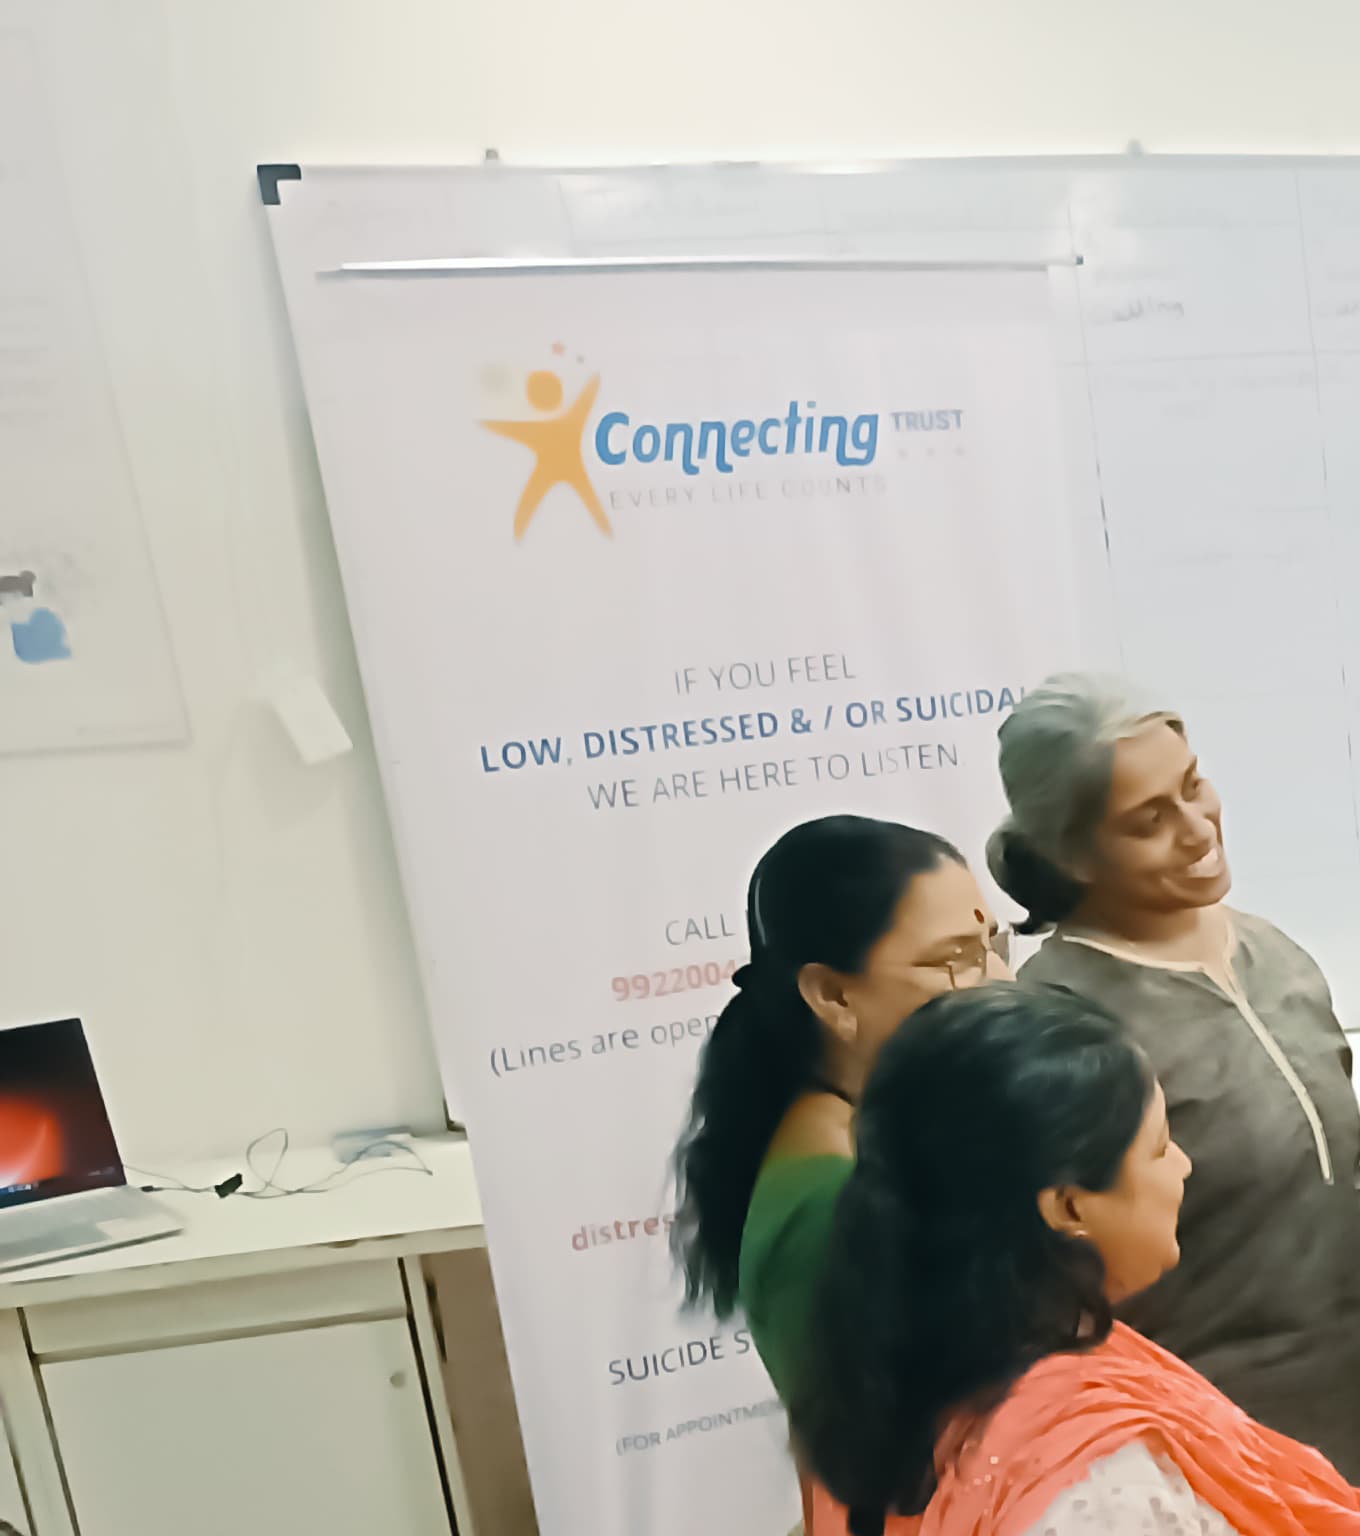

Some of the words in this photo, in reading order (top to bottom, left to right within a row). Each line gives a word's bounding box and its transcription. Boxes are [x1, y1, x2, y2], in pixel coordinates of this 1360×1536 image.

[595, 400, 879, 476] Connecting
[889, 409, 964, 432] TRUST
[609, 486, 697, 510] EVERY
[711, 480, 767, 502] LIFE
[782, 475, 887, 499] COUNTS
[674, 668, 697, 696] IF
[710, 661, 775, 692] YOU
[788, 653, 856, 682] FEEL
[479, 736, 574, 773] LOW,
[584, 710, 779, 759] DISTRESSED
[790, 707, 812, 734] &
[824, 705, 834, 732] /
[845, 700, 886, 730] OR
[896, 686, 1025, 722] SUICIDA
[587, 779, 639, 810] WE
[652, 768, 707, 803] ARE
[720, 758, 798, 793] HERE
[810, 753, 850, 781] TO
[665, 913, 736, 945] CALL
[490, 1039, 581, 1077] (Lines
[591, 1028, 639, 1055] are
[608, 1335, 725, 1385] SUICIDE
[615, 1431, 661, 1456] (FOR
